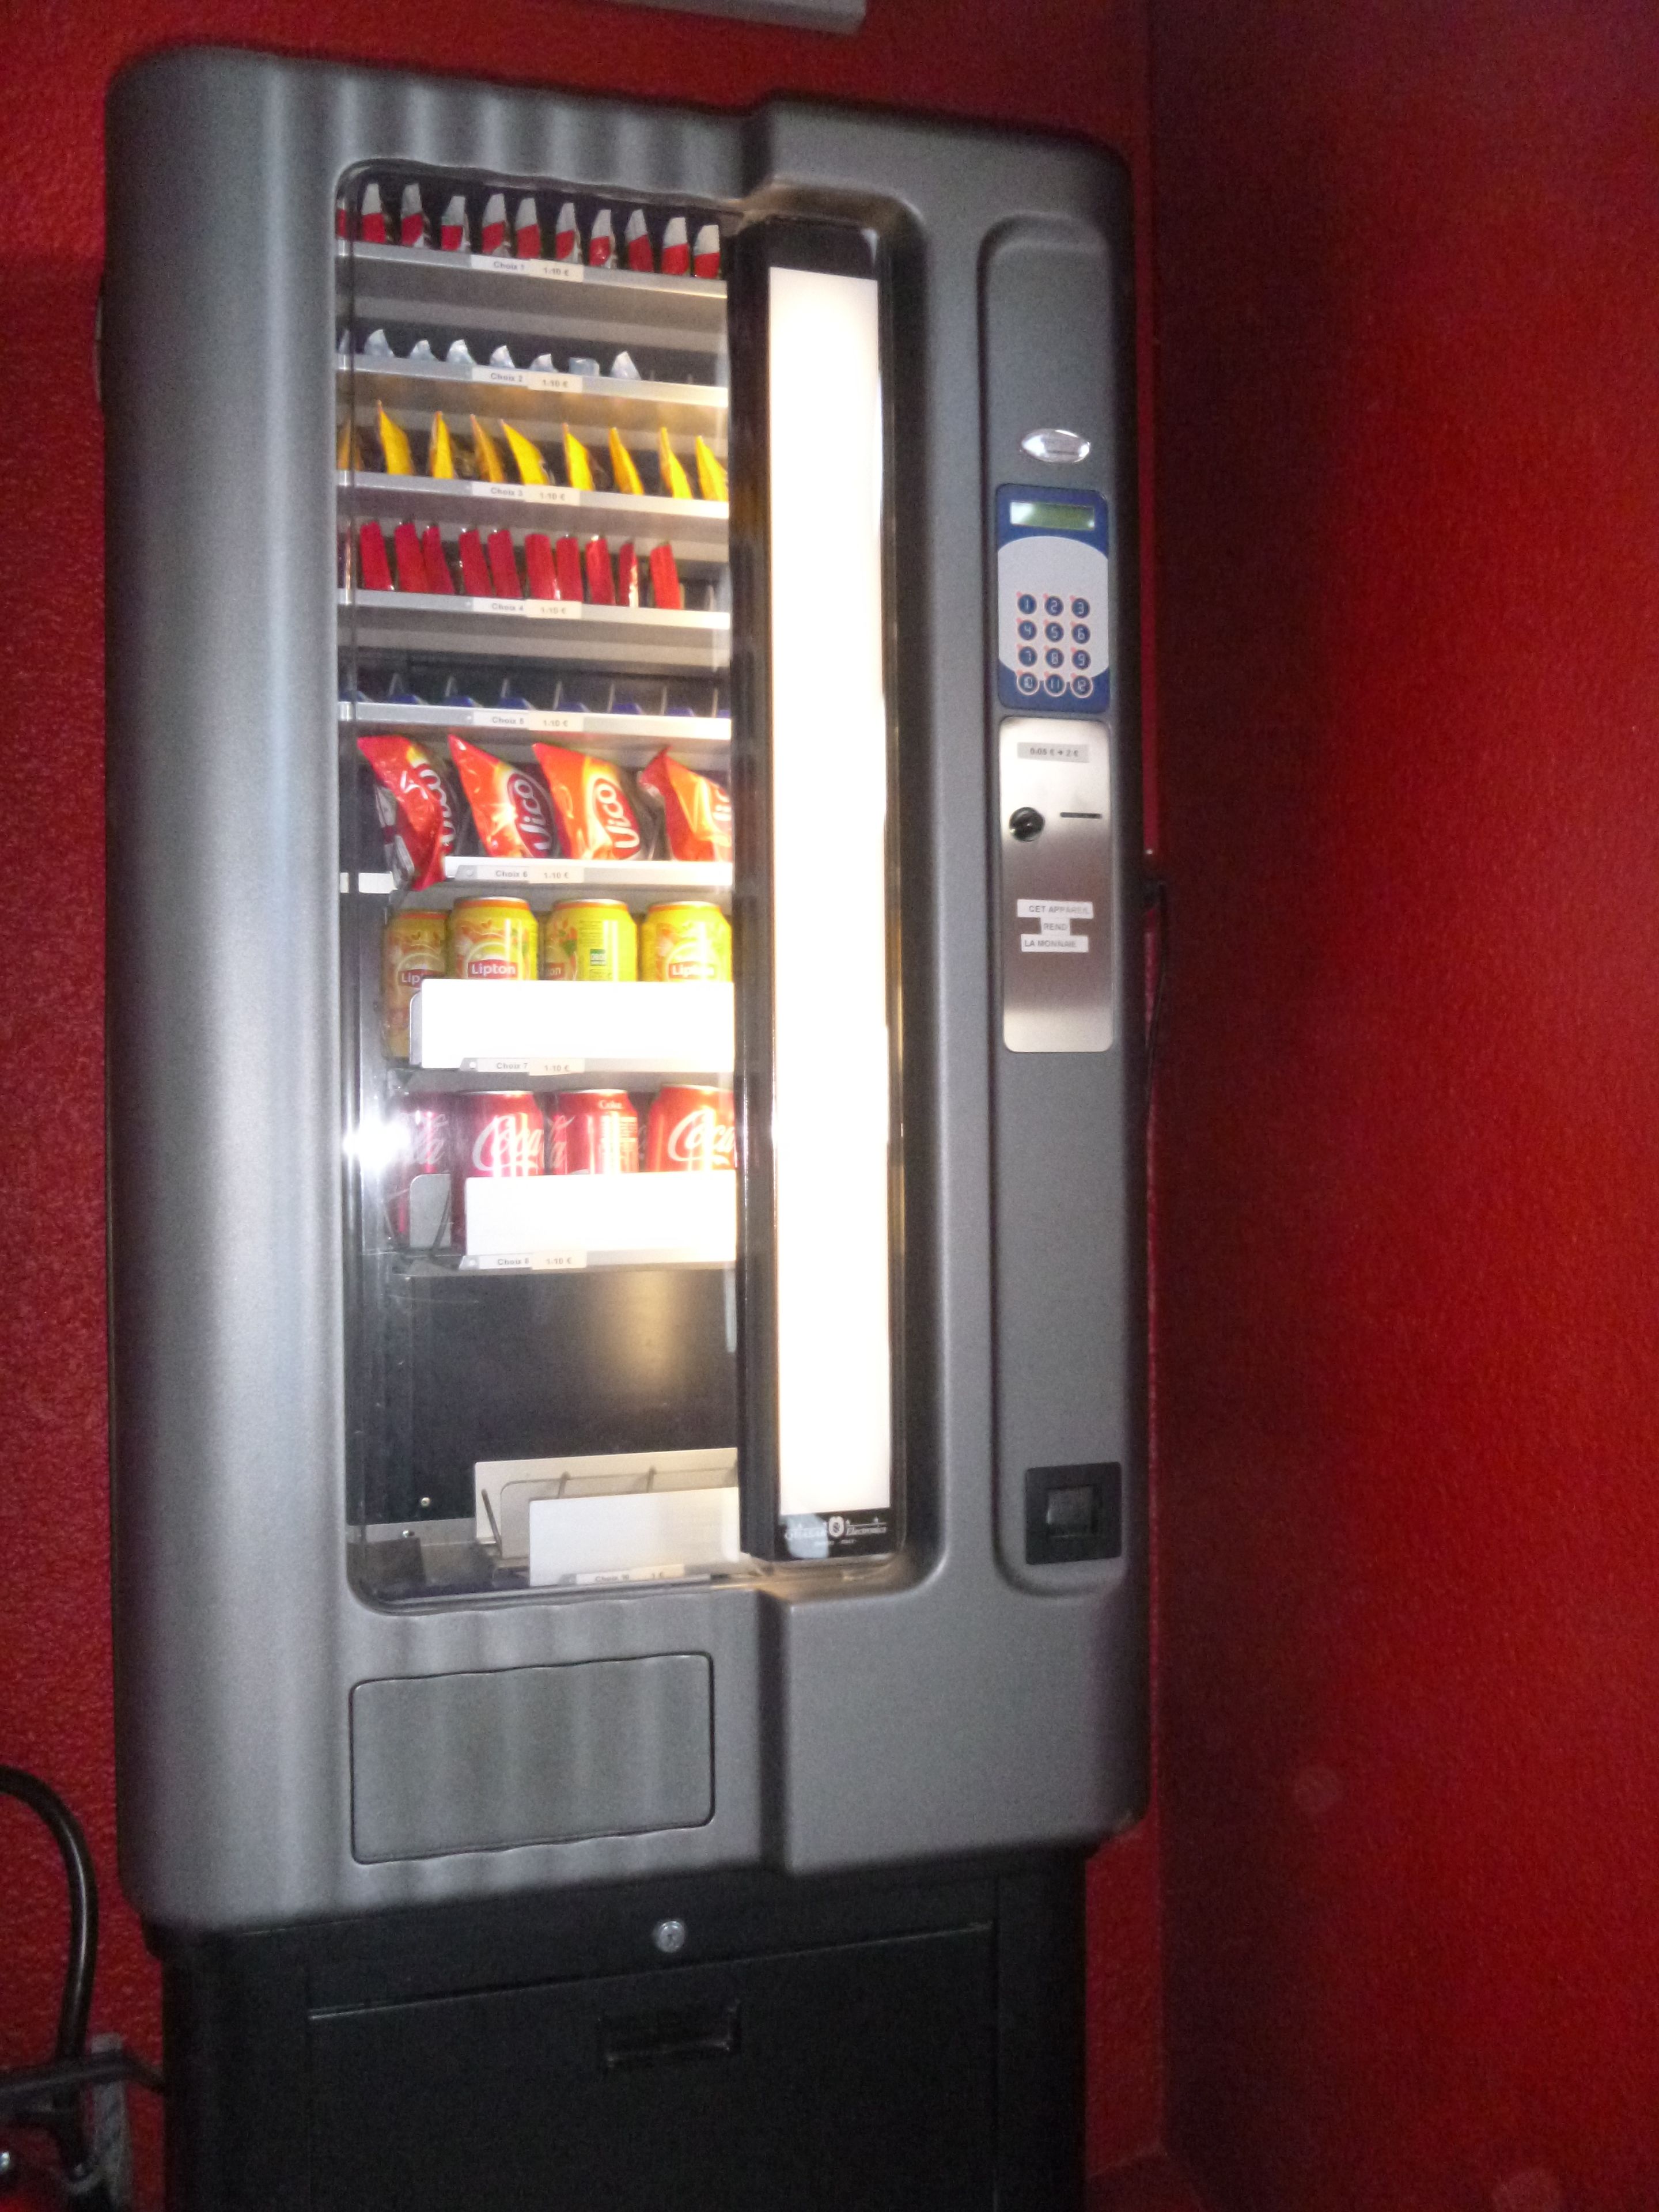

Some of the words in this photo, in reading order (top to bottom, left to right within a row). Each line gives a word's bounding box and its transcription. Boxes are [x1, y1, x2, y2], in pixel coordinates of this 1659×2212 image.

[1051, 600, 1057, 612] 2
[1078, 602, 1084, 614] 3
[1024, 626, 1031, 635] 4
[1051, 626, 1058, 638] 5
[1078, 628, 1085, 640] 6
[1025, 651, 1031, 661] 7
[1051, 652, 1058, 664] 8
[1078, 654, 1085, 666] 9
[1051, 679, 1059, 690] 11
[472, 963, 516, 976] Lipton
